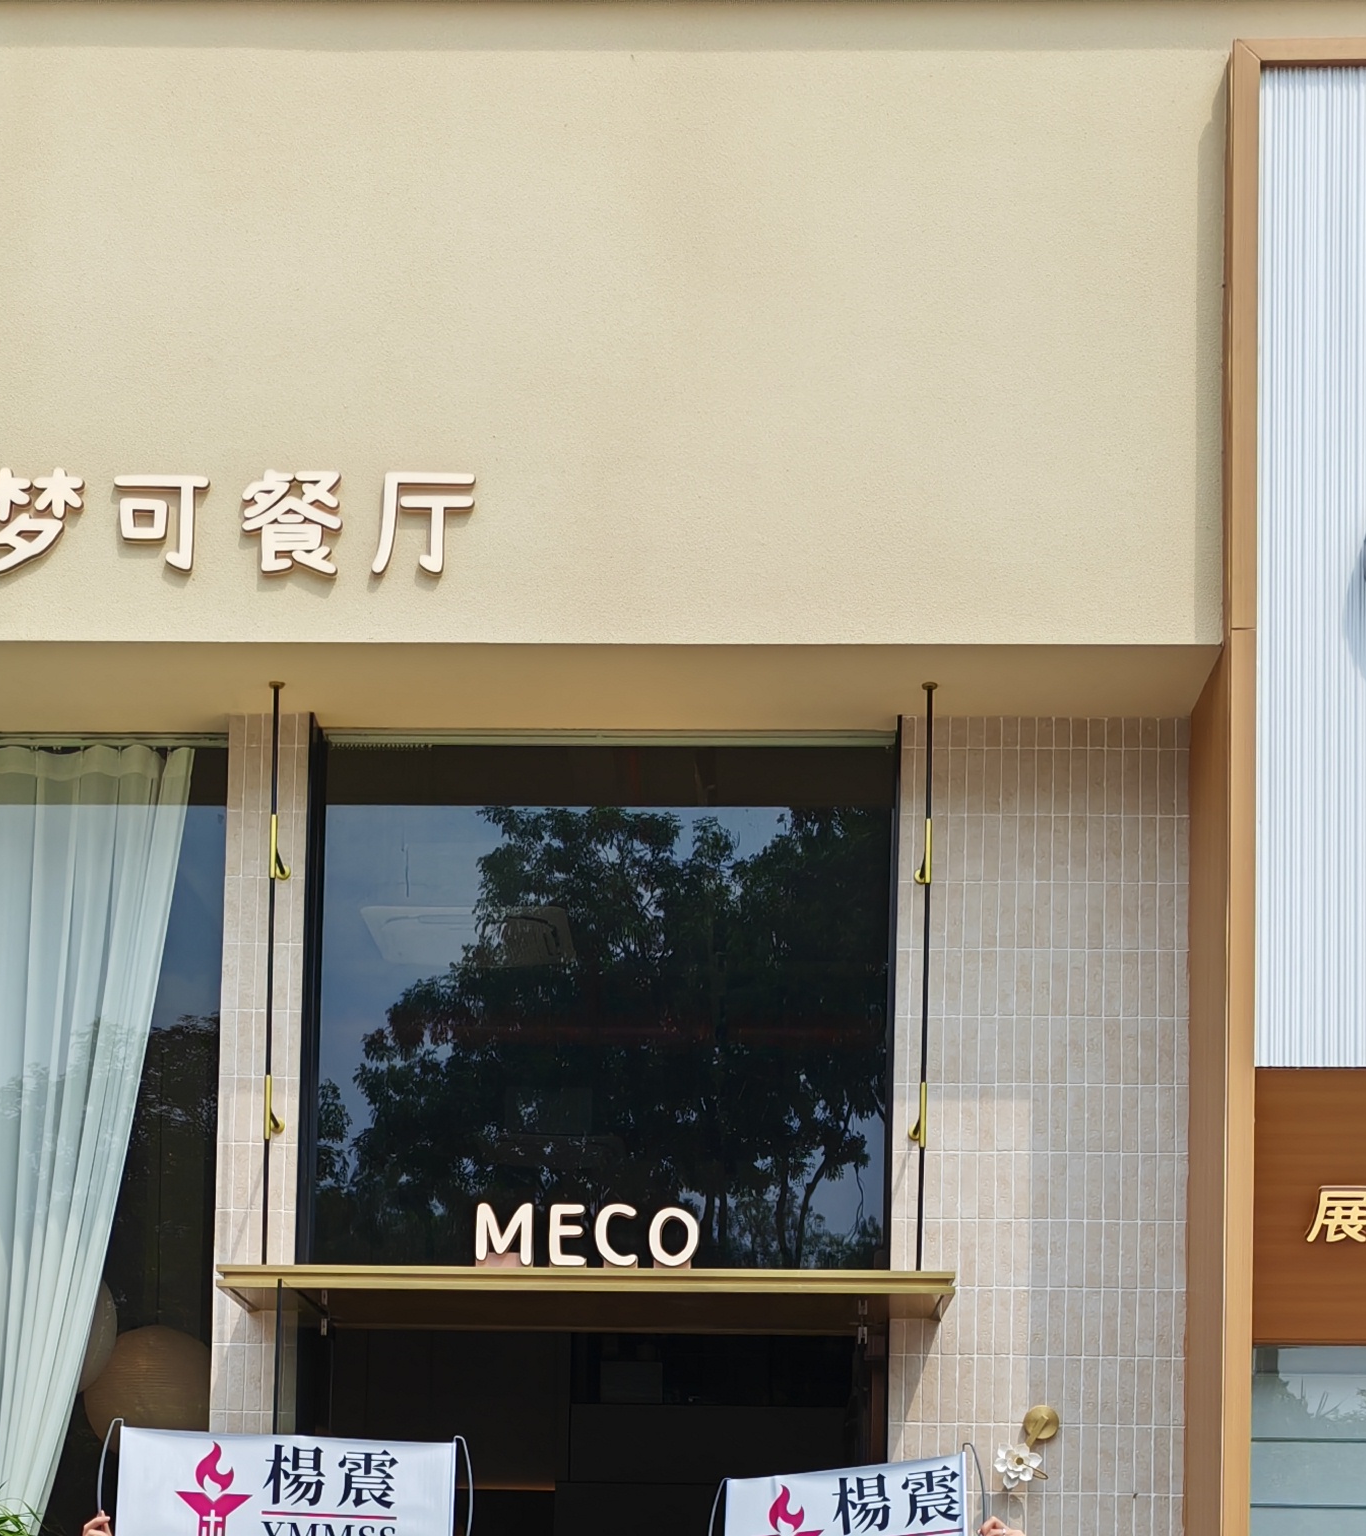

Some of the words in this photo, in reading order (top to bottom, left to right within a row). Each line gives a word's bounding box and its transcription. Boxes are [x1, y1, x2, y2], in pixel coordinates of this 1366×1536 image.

[475, 1203, 699, 1266] MECO
[262, 1444, 399, 1509] 楊震
[832, 1465, 961, 1536] 楊震
